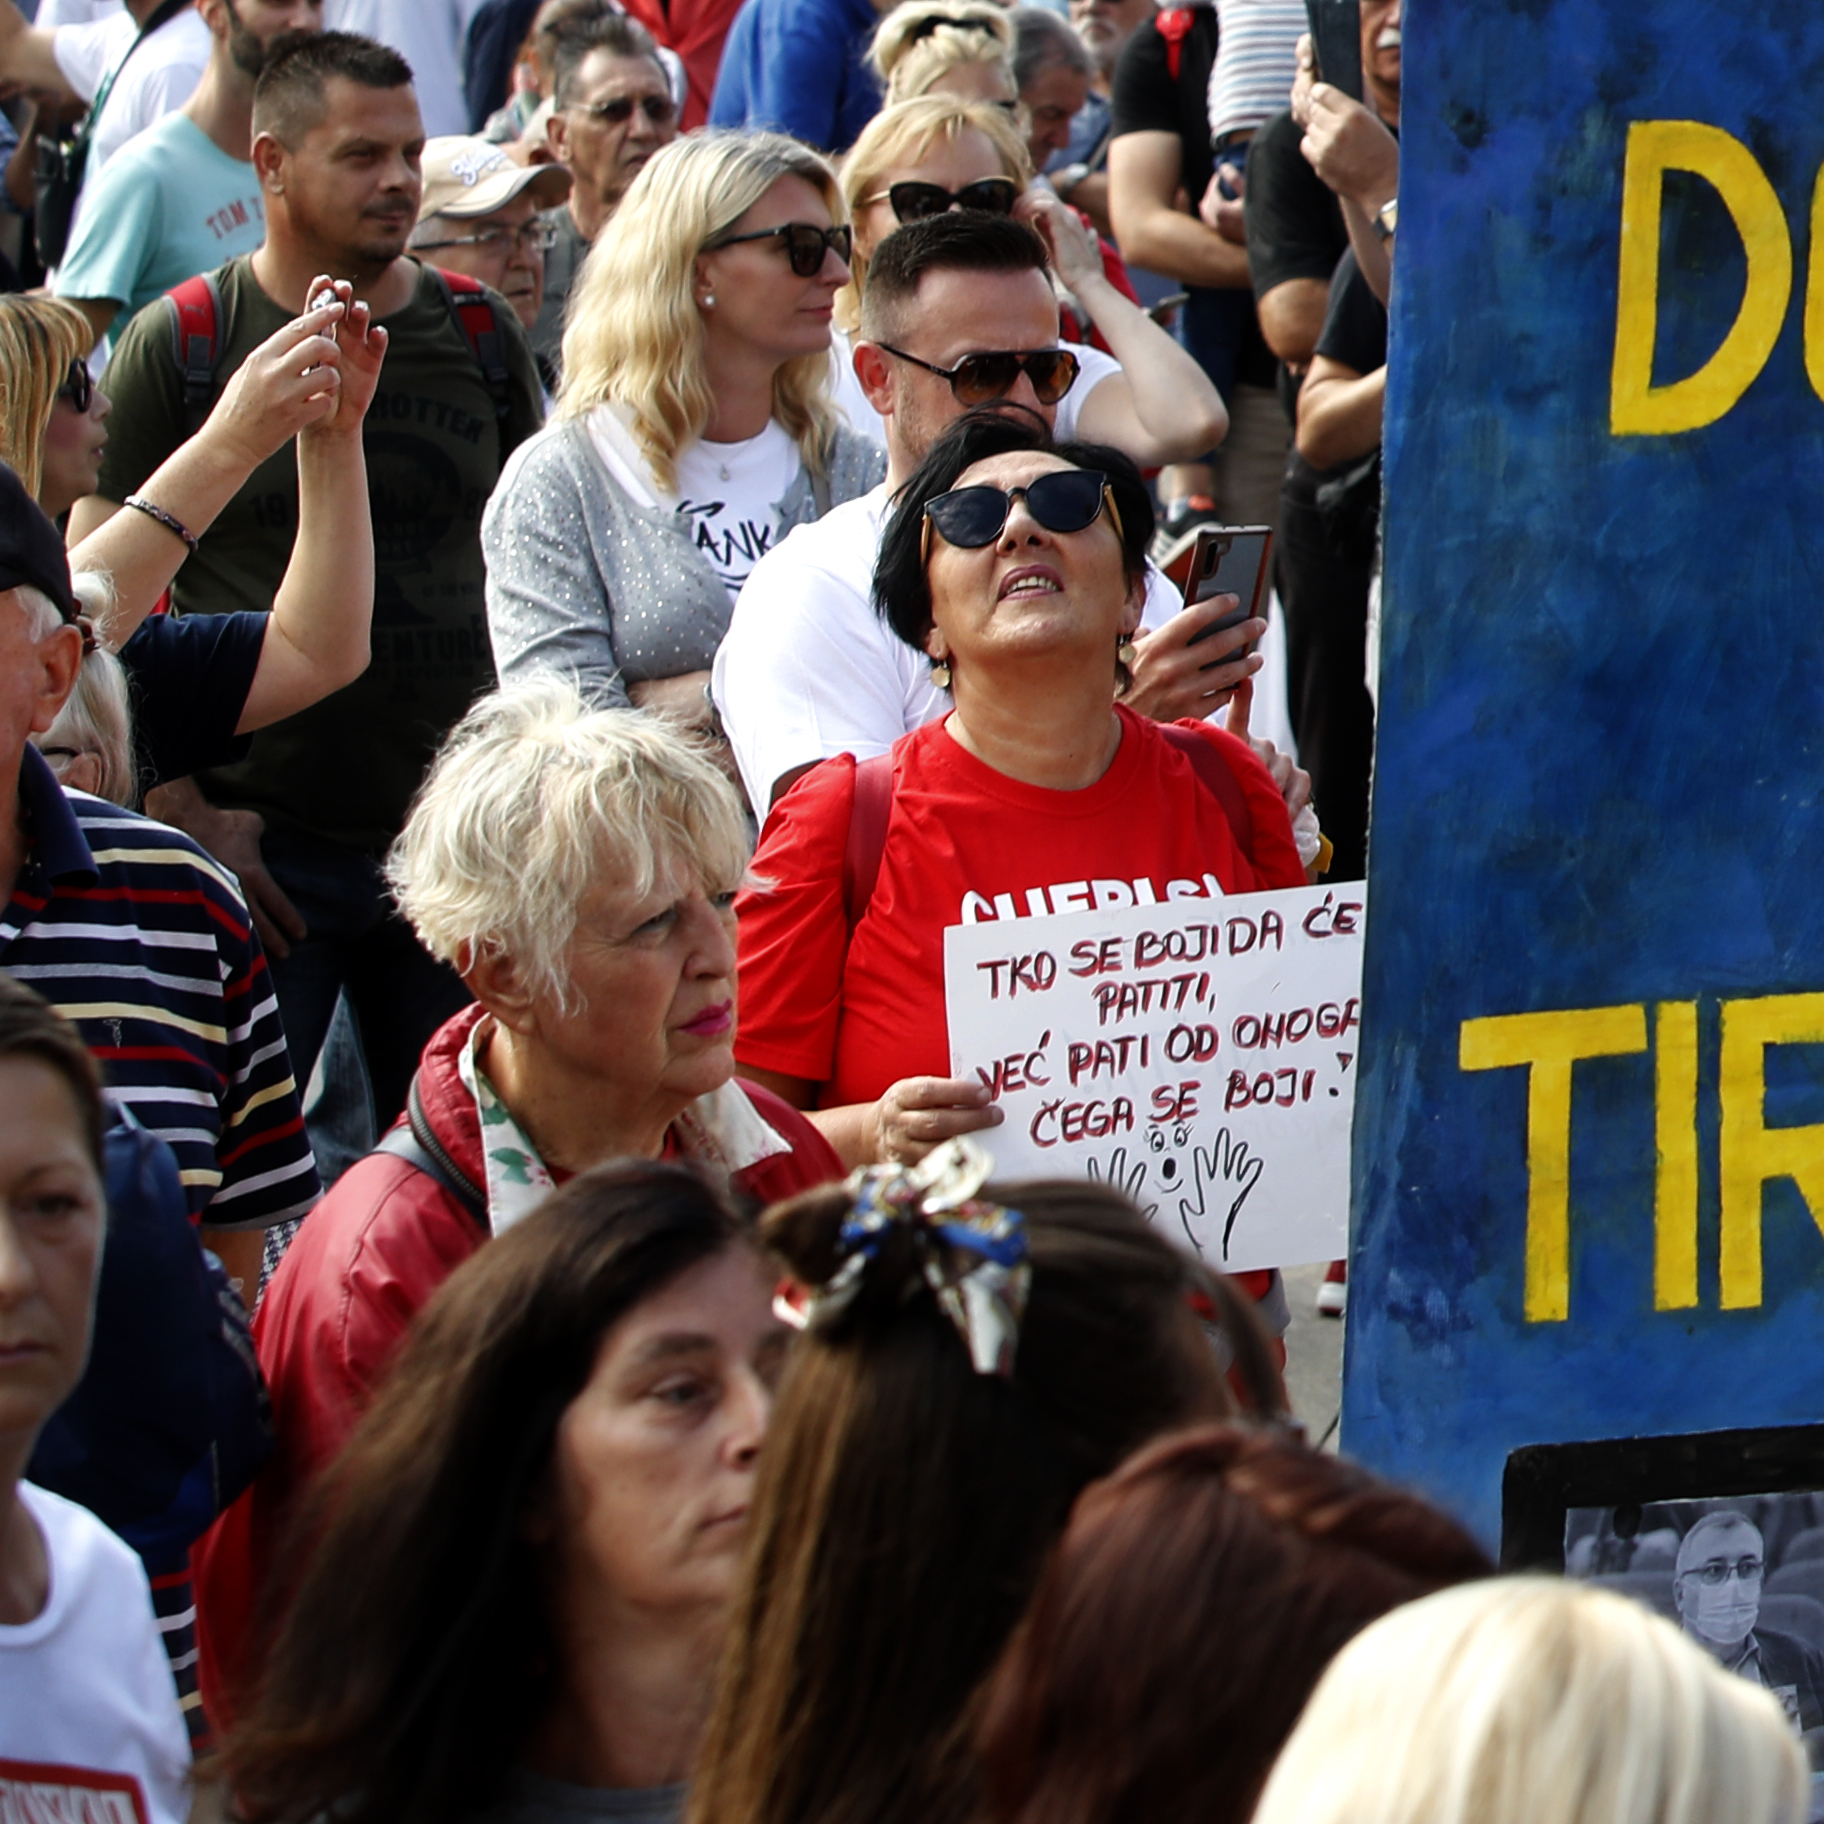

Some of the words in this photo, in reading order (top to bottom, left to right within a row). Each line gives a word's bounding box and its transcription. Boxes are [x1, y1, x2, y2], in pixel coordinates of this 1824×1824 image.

[976, 949, 1058, 1000] TKO
[1068, 935, 1123, 978] SE
[1133, 924, 1219, 971] BOJI
[1226, 910, 1284, 956] DA
[1302, 890, 1363, 939] ĆE
[976, 1029, 1051, 1103] VEĆ
[1068, 1034, 1150, 1087] PATI
[1163, 1024, 1219, 1064] OD
[1029, 1097, 1135, 1148] ČEGA
[1147, 1080, 1201, 1124] SE
